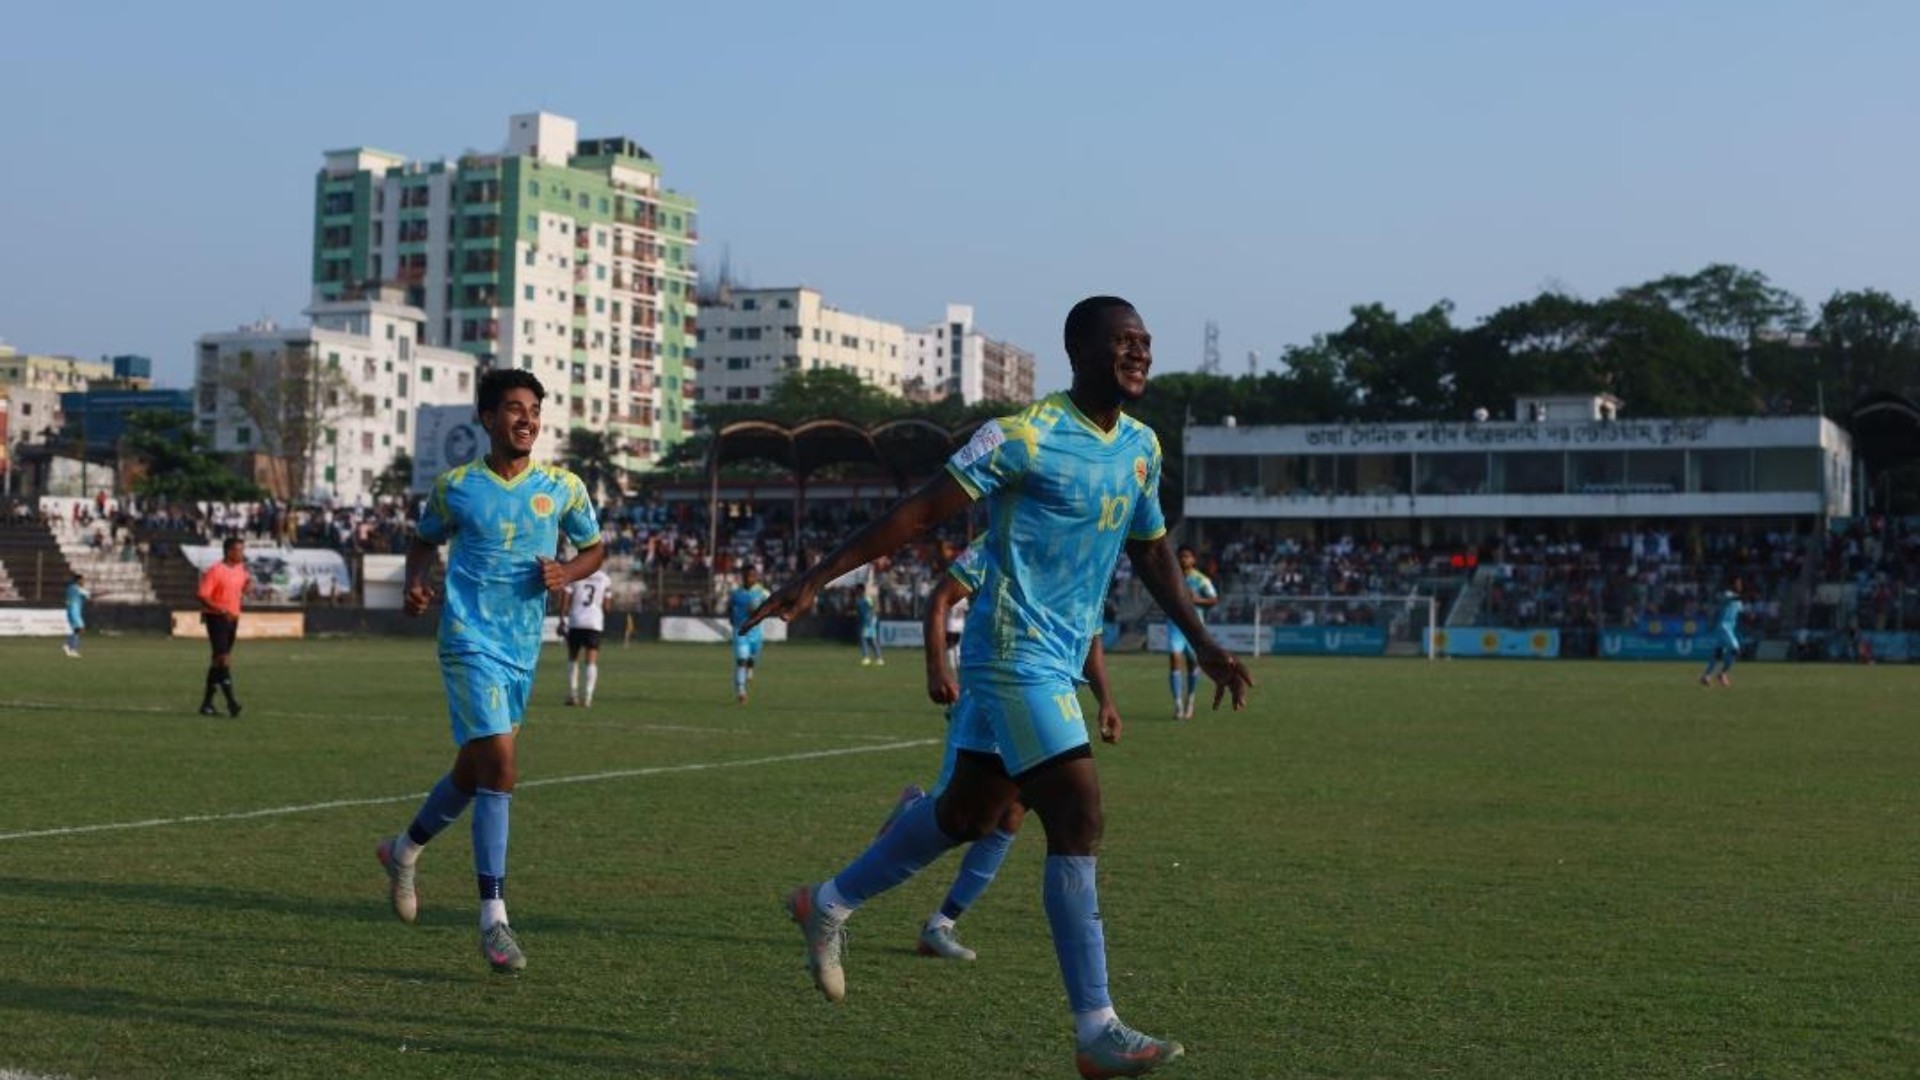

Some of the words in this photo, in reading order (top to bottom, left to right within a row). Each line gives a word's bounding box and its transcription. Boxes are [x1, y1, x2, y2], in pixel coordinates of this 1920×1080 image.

[1098, 493, 1128, 532] 10
[500, 521, 516, 550] 7
[583, 583, 596, 608] 3
[486, 686, 499, 711] 7
